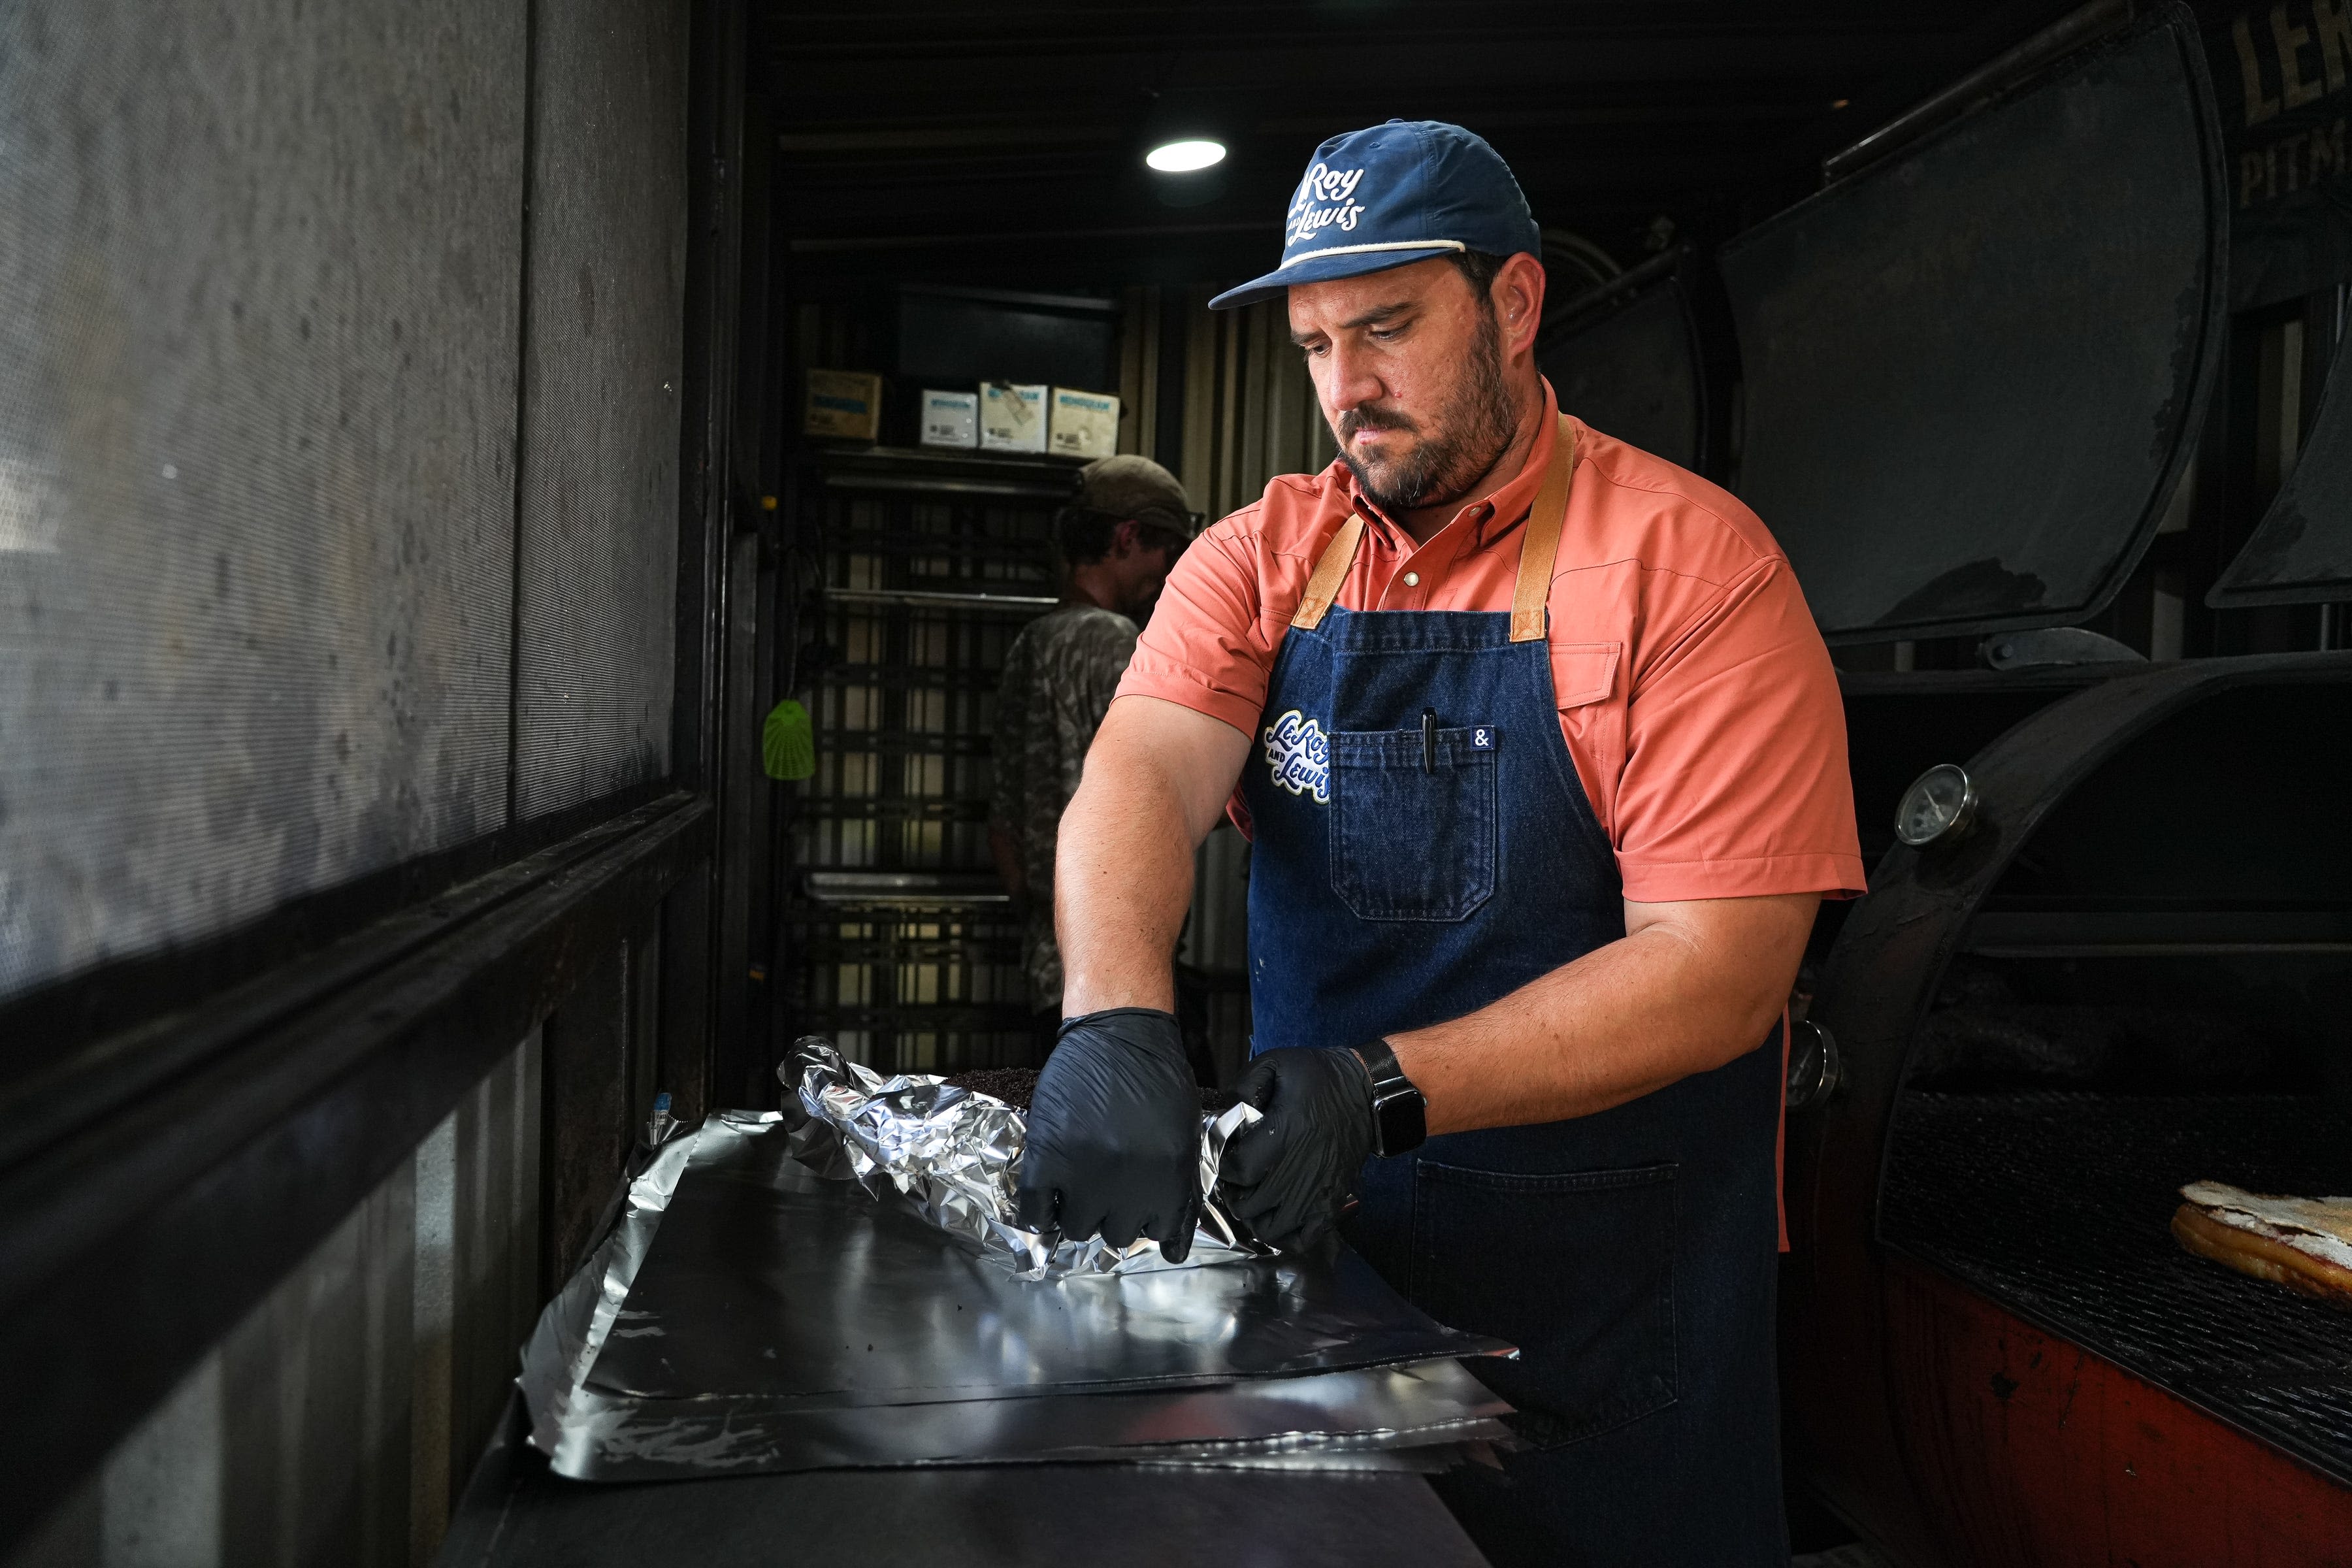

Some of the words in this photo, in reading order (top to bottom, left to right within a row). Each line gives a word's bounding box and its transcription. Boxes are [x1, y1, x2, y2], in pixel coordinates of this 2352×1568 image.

[2240, 118, 2352, 208] PITM
[1287, 197, 1365, 247] Lewis
[1475, 728, 1489, 746] &
[1268, 749, 1285, 763] AND
